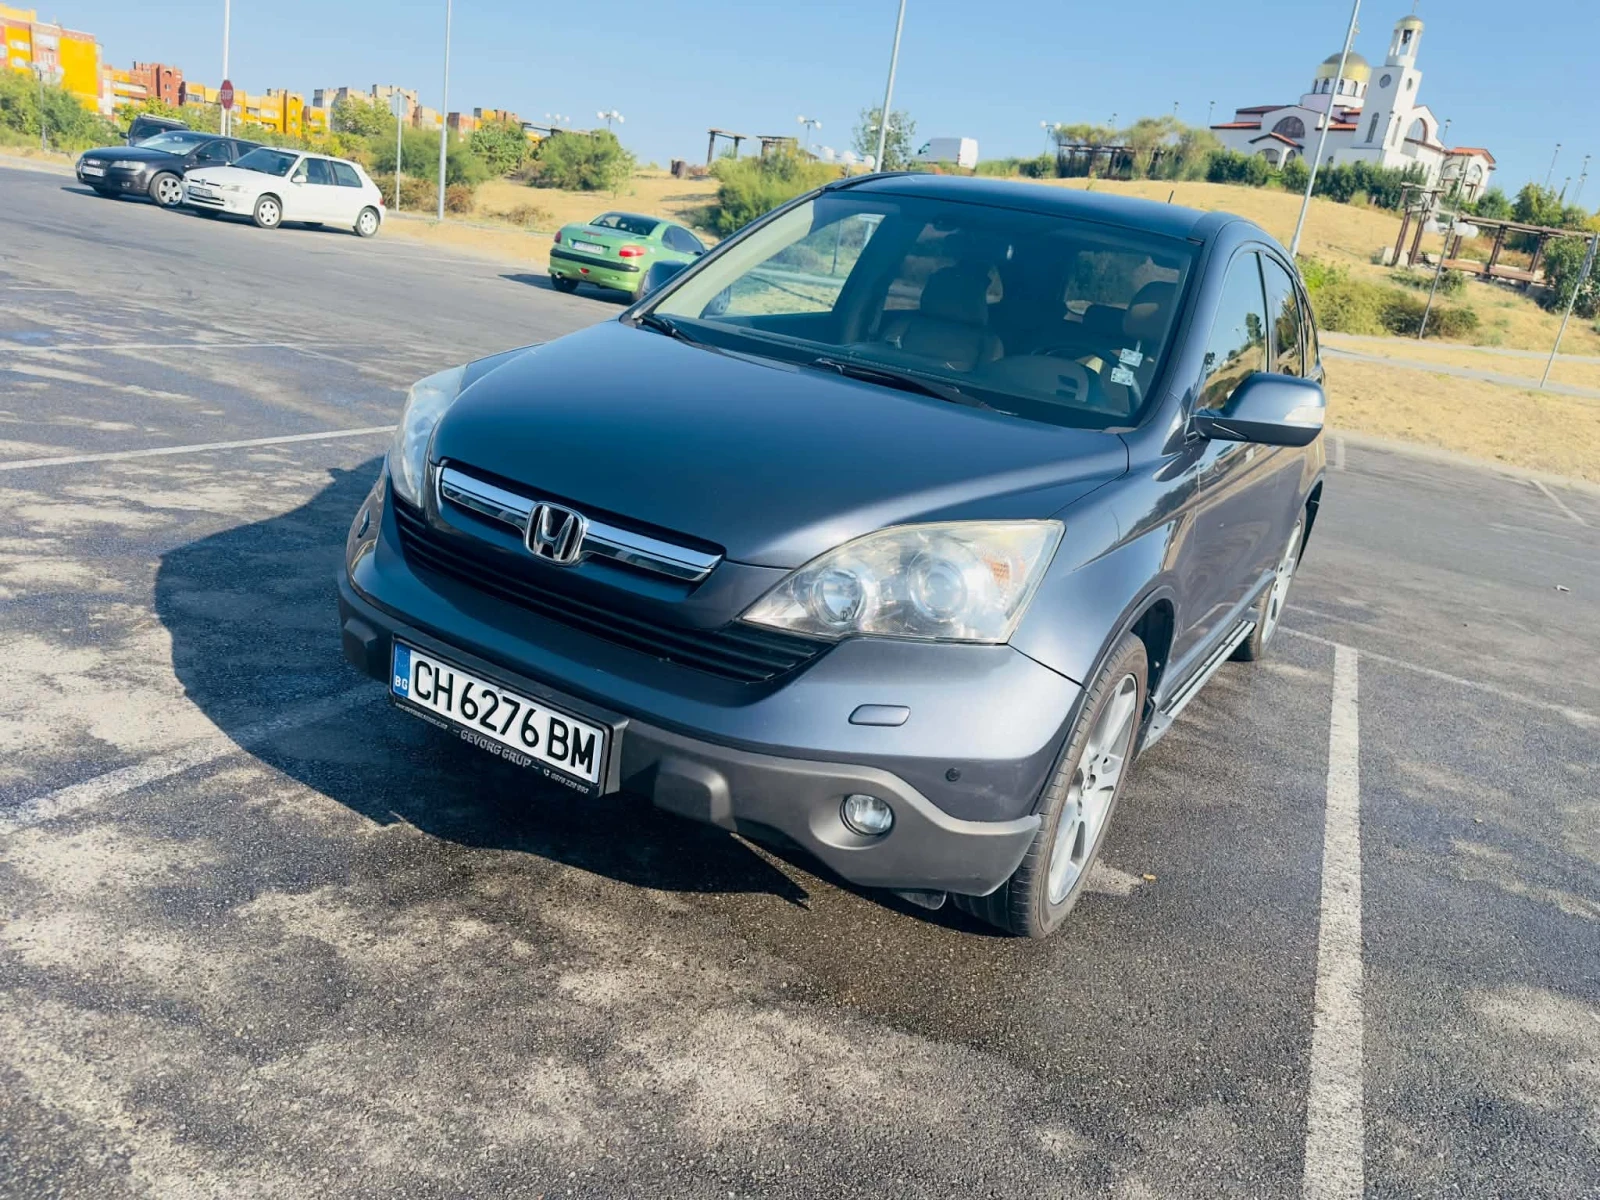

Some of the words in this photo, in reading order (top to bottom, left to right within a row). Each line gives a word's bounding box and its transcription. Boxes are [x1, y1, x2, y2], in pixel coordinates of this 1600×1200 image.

[221, 89, 233, 101] STOP
[395, 675, 409, 691] BG
[460, 681, 540, 749] 6276
[460, 729, 502, 756] GEVORG
[501, 748, 532, 768] GRUP
